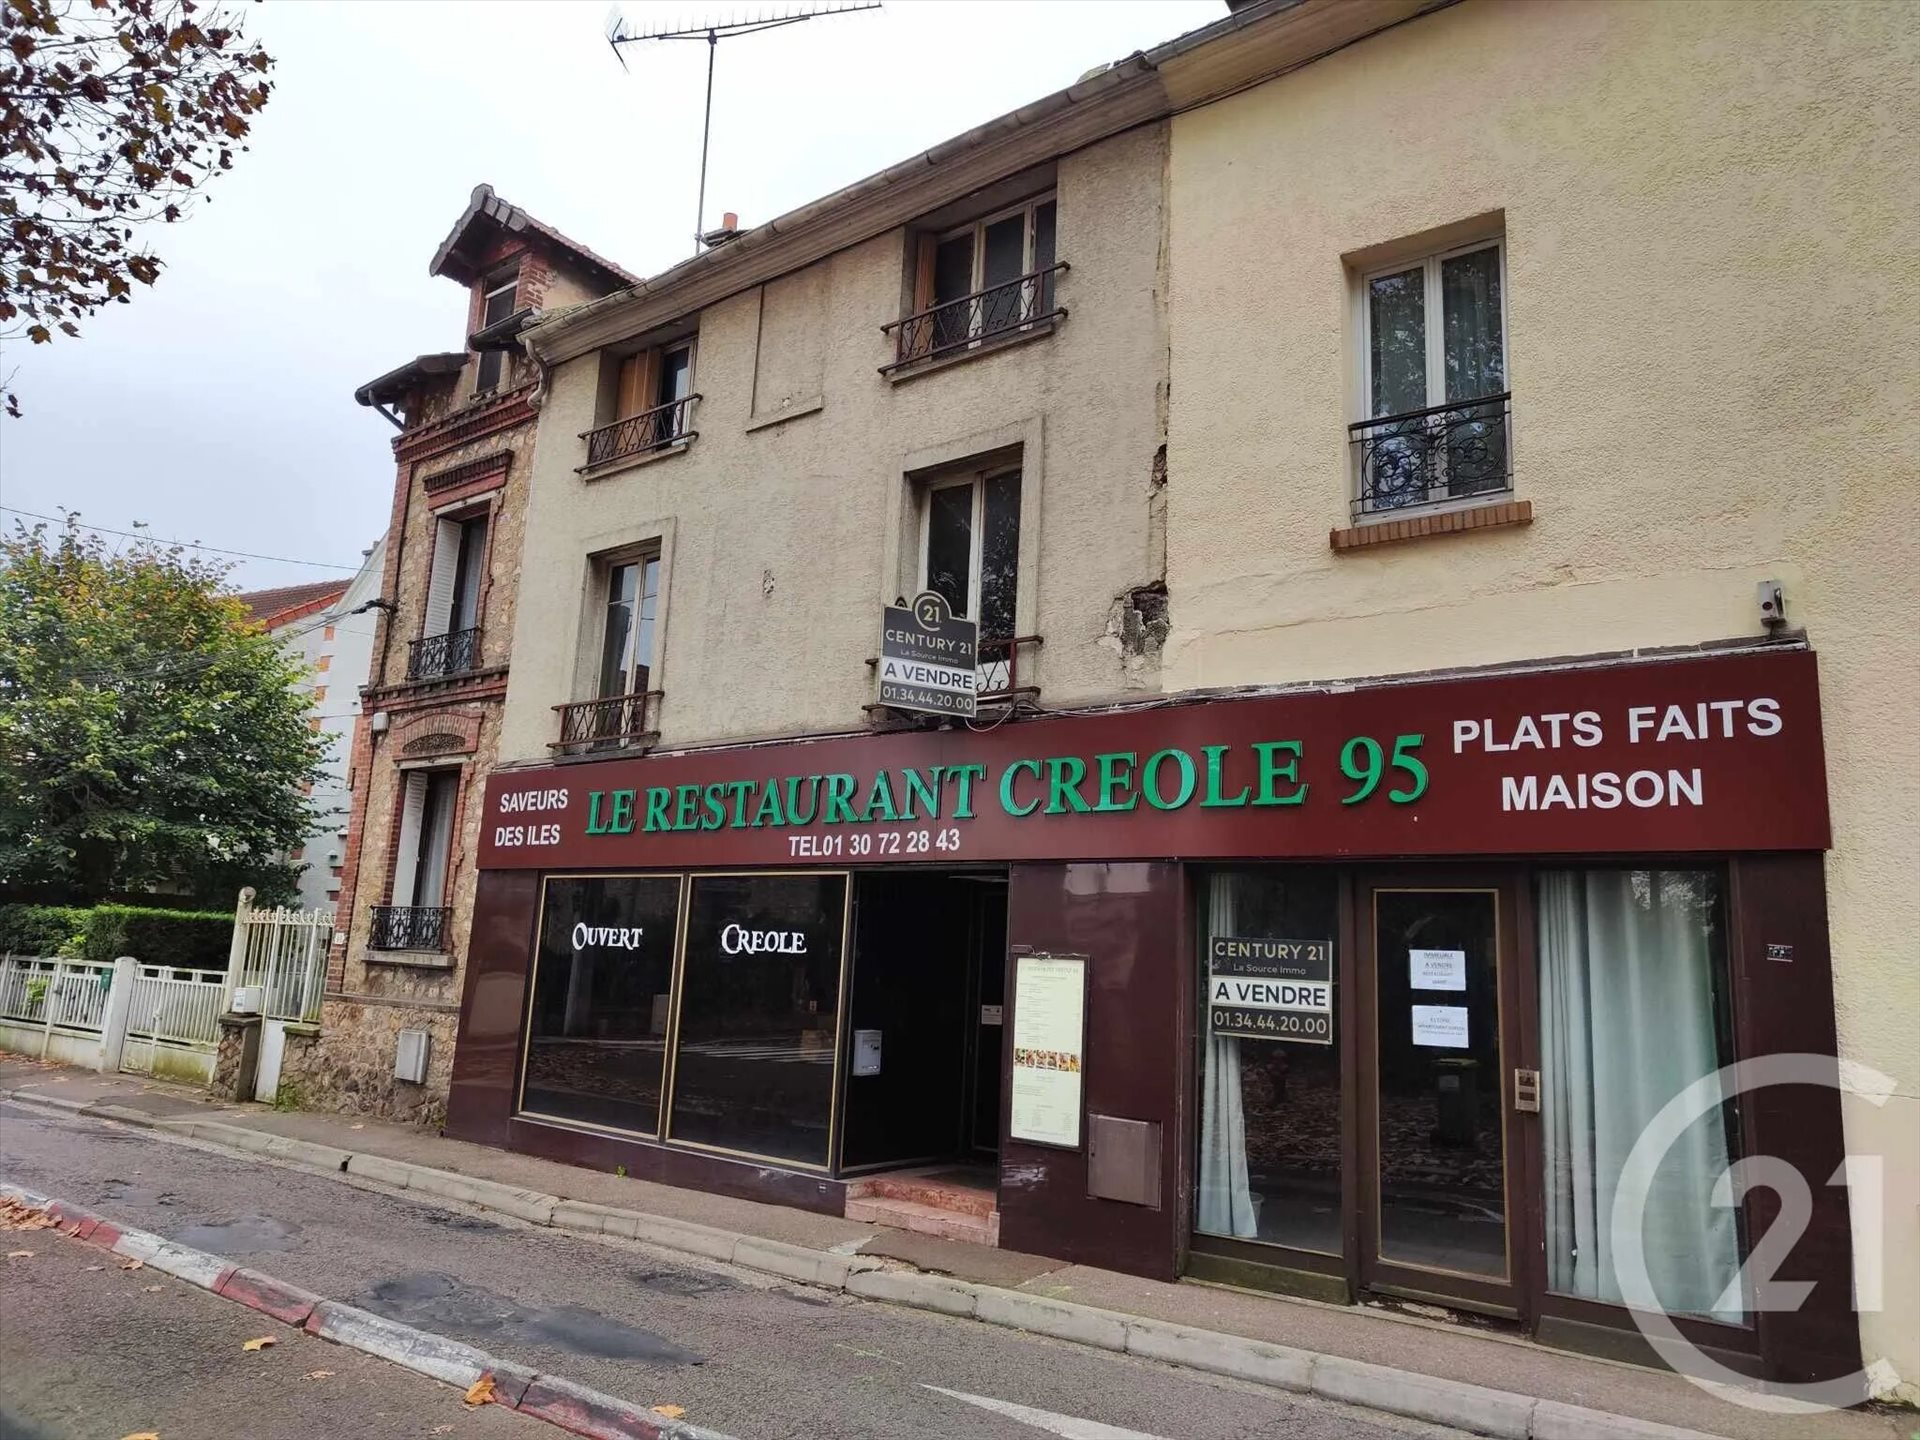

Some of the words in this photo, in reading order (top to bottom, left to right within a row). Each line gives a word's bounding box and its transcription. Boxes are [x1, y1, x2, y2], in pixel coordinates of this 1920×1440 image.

[923, 605, 940, 623] 21
[885, 629, 955, 651] CENTURY
[960, 642, 972, 655] 21
[885, 663, 897, 678] A
[903, 665, 973, 689] VENDRE
[883, 685, 973, 710] 01.34.44.20.00
[1453, 710, 1603, 754] PLATS
[1628, 698, 1783, 743] FAITS
[585, 789, 637, 834] LE
[641, 764, 988, 833] RESTAURANT
[1000, 740, 1309, 817] CREOLE
[1340, 733, 1429, 806] 95
[1502, 768, 1703, 811] MAISON
[500, 789, 568, 813] SAVEURS
[495, 826, 524, 846] DES
[527, 824, 561, 845] ILES
[849, 834, 871, 855] 30
[878, 832, 901, 854] 72
[906, 830, 930, 853] 28
[935, 828, 961, 851] 43
[1215, 942, 1302, 959] CENTURY
[1307, 946, 1323, 961] 21
[1233, 964, 1244, 972] La
[1246, 964, 1278, 973] Source
[1280, 966, 1307, 975] Immo
[1215, 982, 1230, 1000] A
[1236, 983, 1326, 1007] VENDRE
[1214, 1011, 1327, 1034] 01.34.44.20.00
